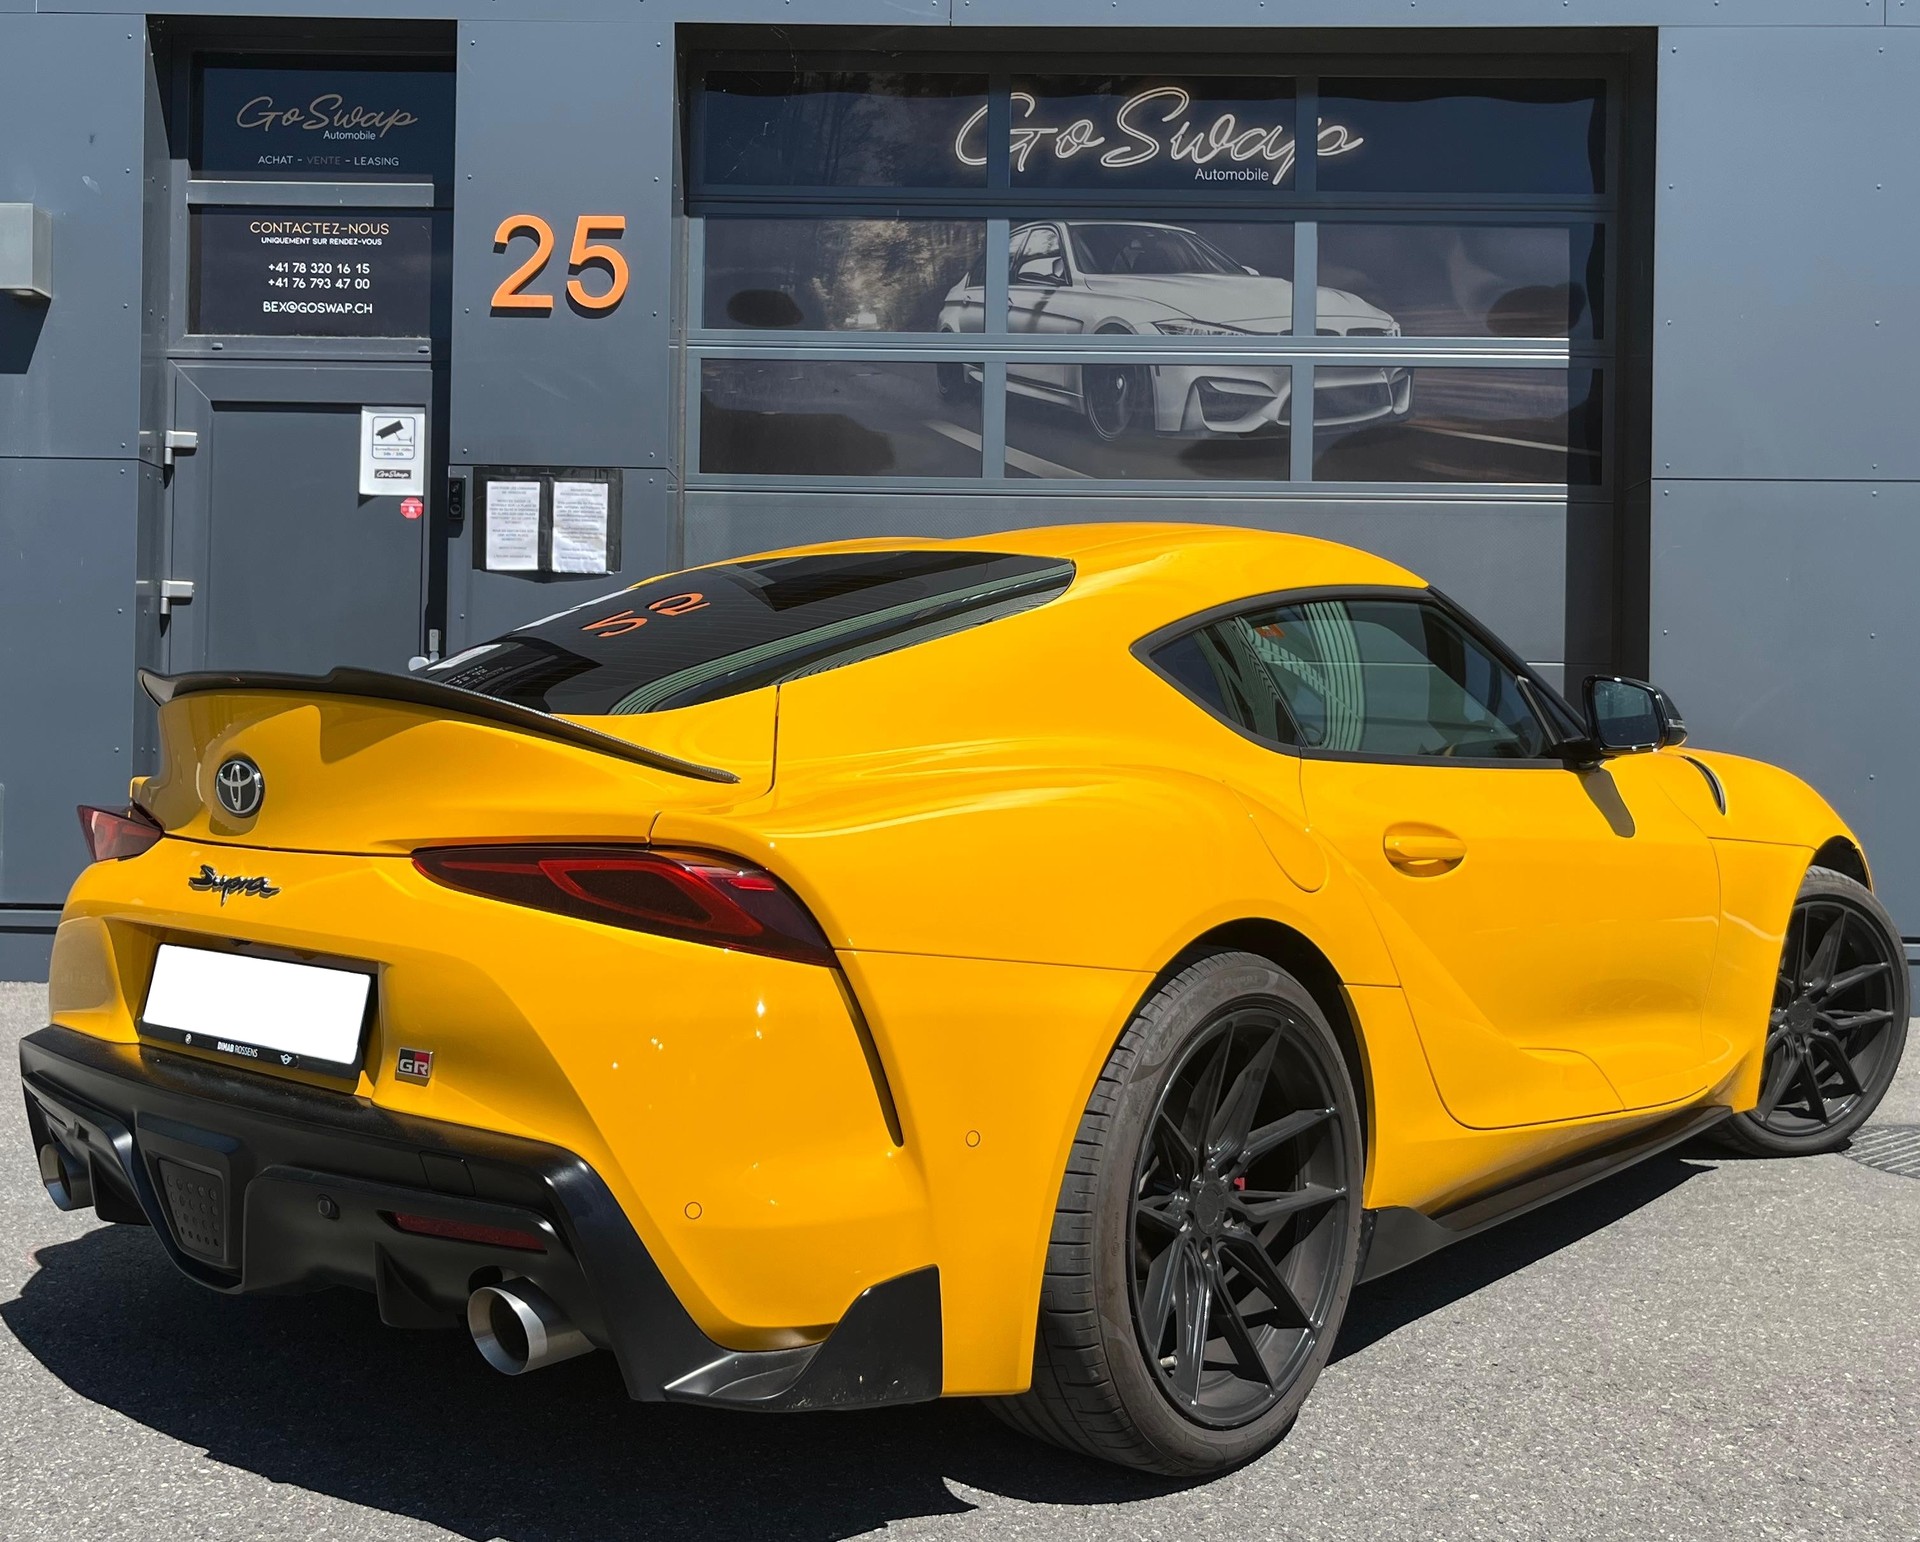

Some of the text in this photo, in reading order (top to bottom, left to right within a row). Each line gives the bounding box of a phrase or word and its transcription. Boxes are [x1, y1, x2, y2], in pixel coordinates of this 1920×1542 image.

[323, 130, 376, 140] Automobile
[257, 155, 294, 165] ACHAT
[306, 156, 341, 165] VENTE
[354, 156, 400, 166] LEASING
[1194, 168, 1270, 182] Automobile
[249, 221, 390, 235] CONTACTEZ-NOUS
[261, 236, 383, 246] UNIQUEMENT SUR RENDEZ-VOUS
[268, 262, 370, 274] +41 78 320 16 15
[490, 213, 630, 310] 25
[268, 277, 371, 290] +41 76 793 47 00
[262, 301, 373, 314] BEX@GOSWAP.CH
[188, 864, 281, 908] Supra
[234, 1044, 259, 1058] ROSSENS
[399, 1058, 429, 1076] GR
